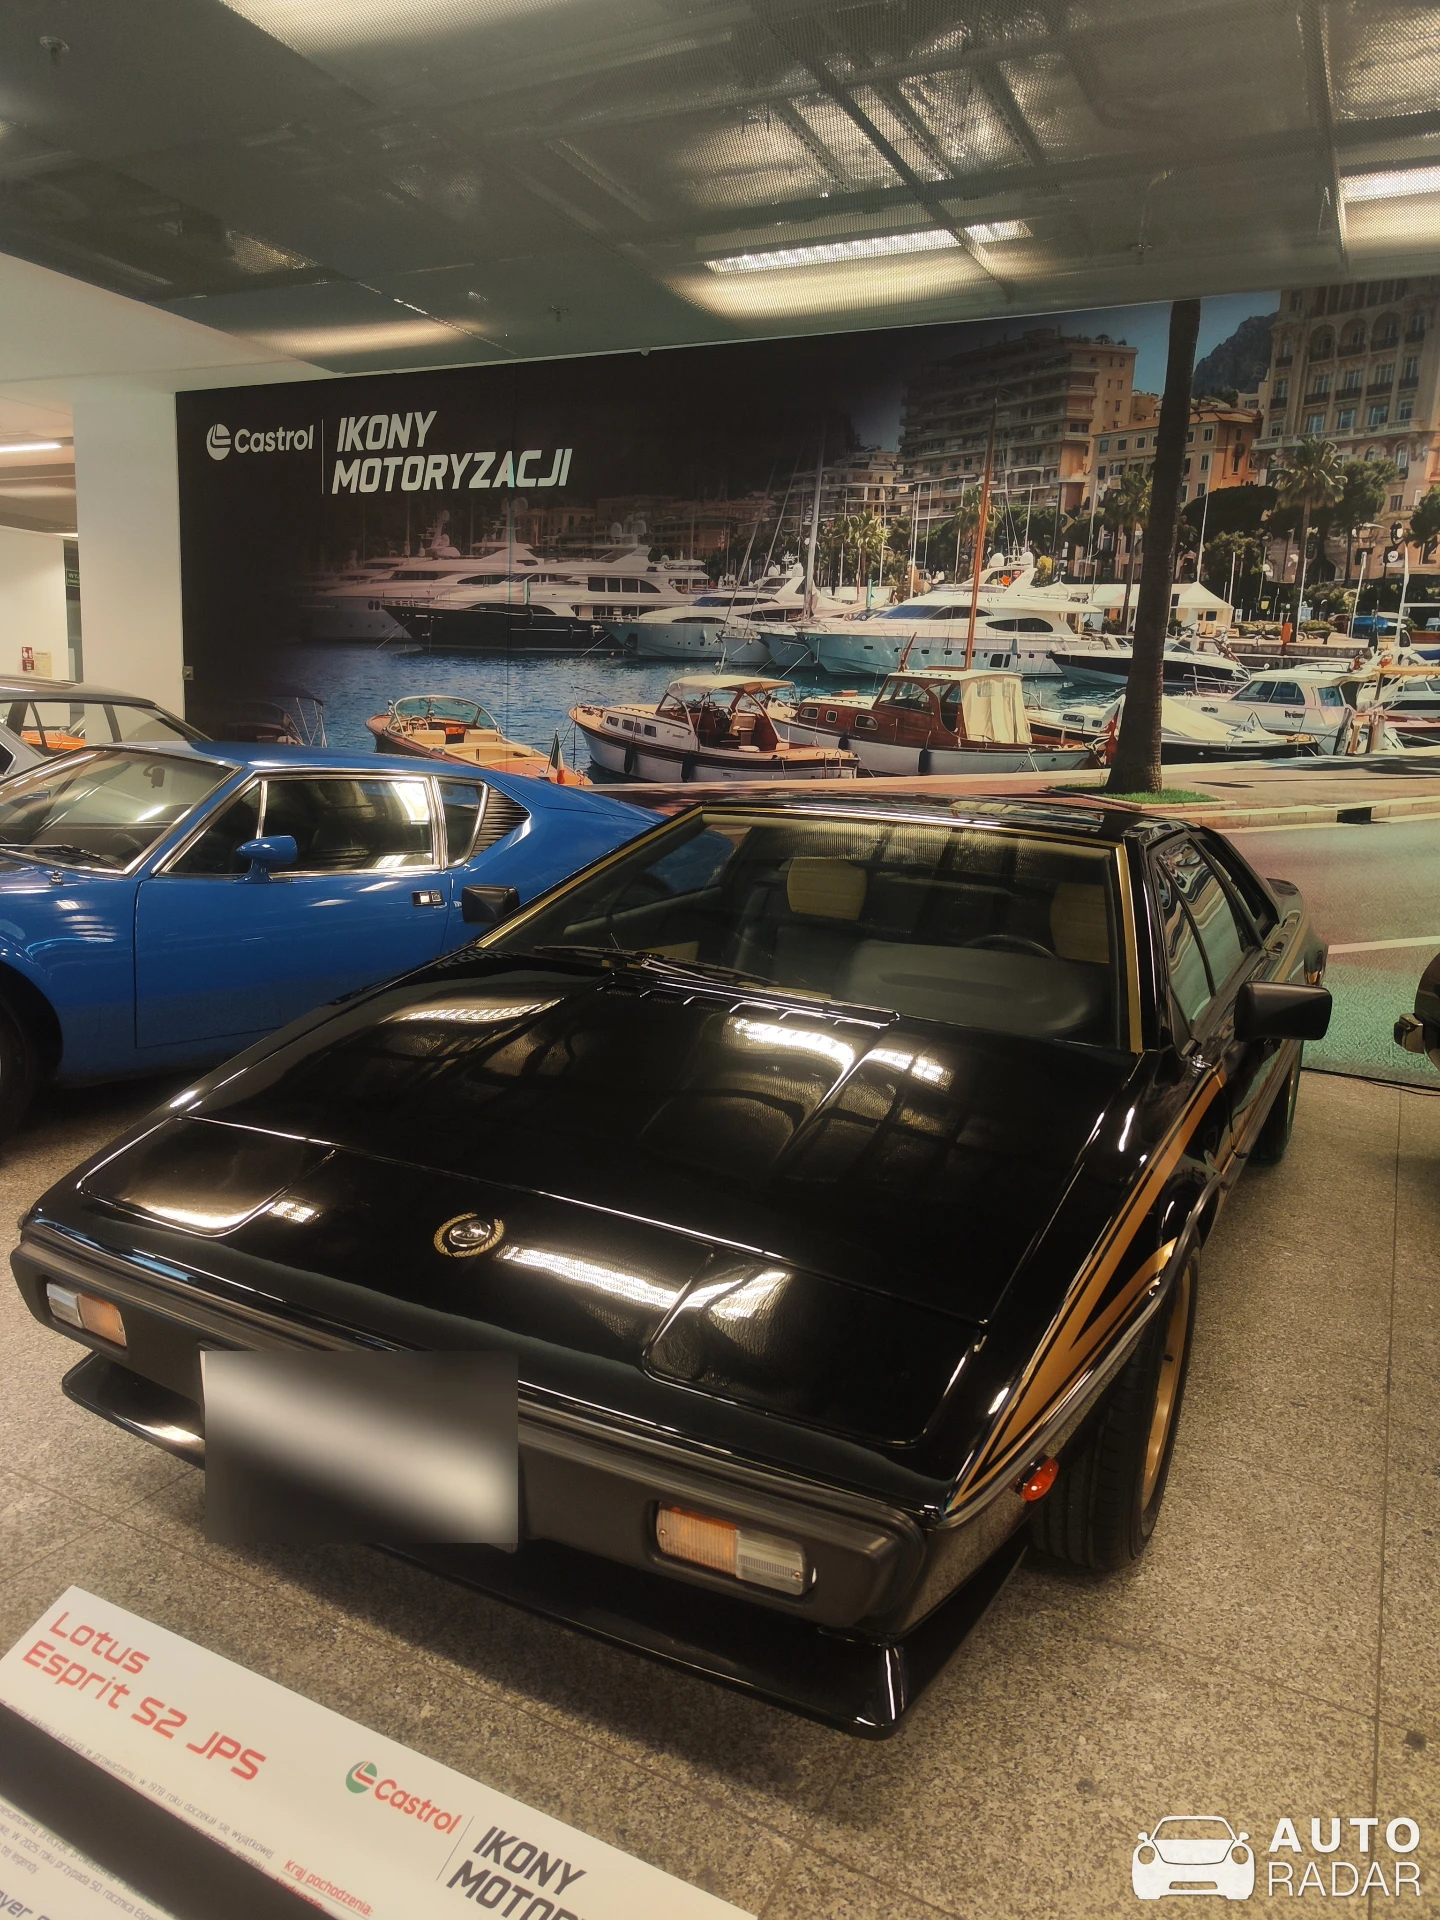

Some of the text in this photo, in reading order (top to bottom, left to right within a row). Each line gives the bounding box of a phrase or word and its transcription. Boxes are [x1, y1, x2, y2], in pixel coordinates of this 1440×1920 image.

[234, 424, 314, 454] Castrol
[336, 410, 437, 453] IKONY
[331, 448, 573, 495] MOTORYZACJI
[49, 1611, 151, 1675] Lotus
[22, 1640, 267, 1781] Esprit S2 JPS
[148, 1781, 165, 1796] 1978
[165, 1791, 183, 1807] roku
[374, 1779, 462, 1835] Castrol
[20, 1837, 40, 1854] 2025
[38, 1850, 56, 1865] roku
[54, 1860, 91, 1886] przypada
[102, 1889, 135, 1914] rocznica
[283, 1860, 373, 1916] Kraj pochodzenia:
[472, 1826, 587, 1896] IKONY
[446, 1860, 588, 1920] MOTO
